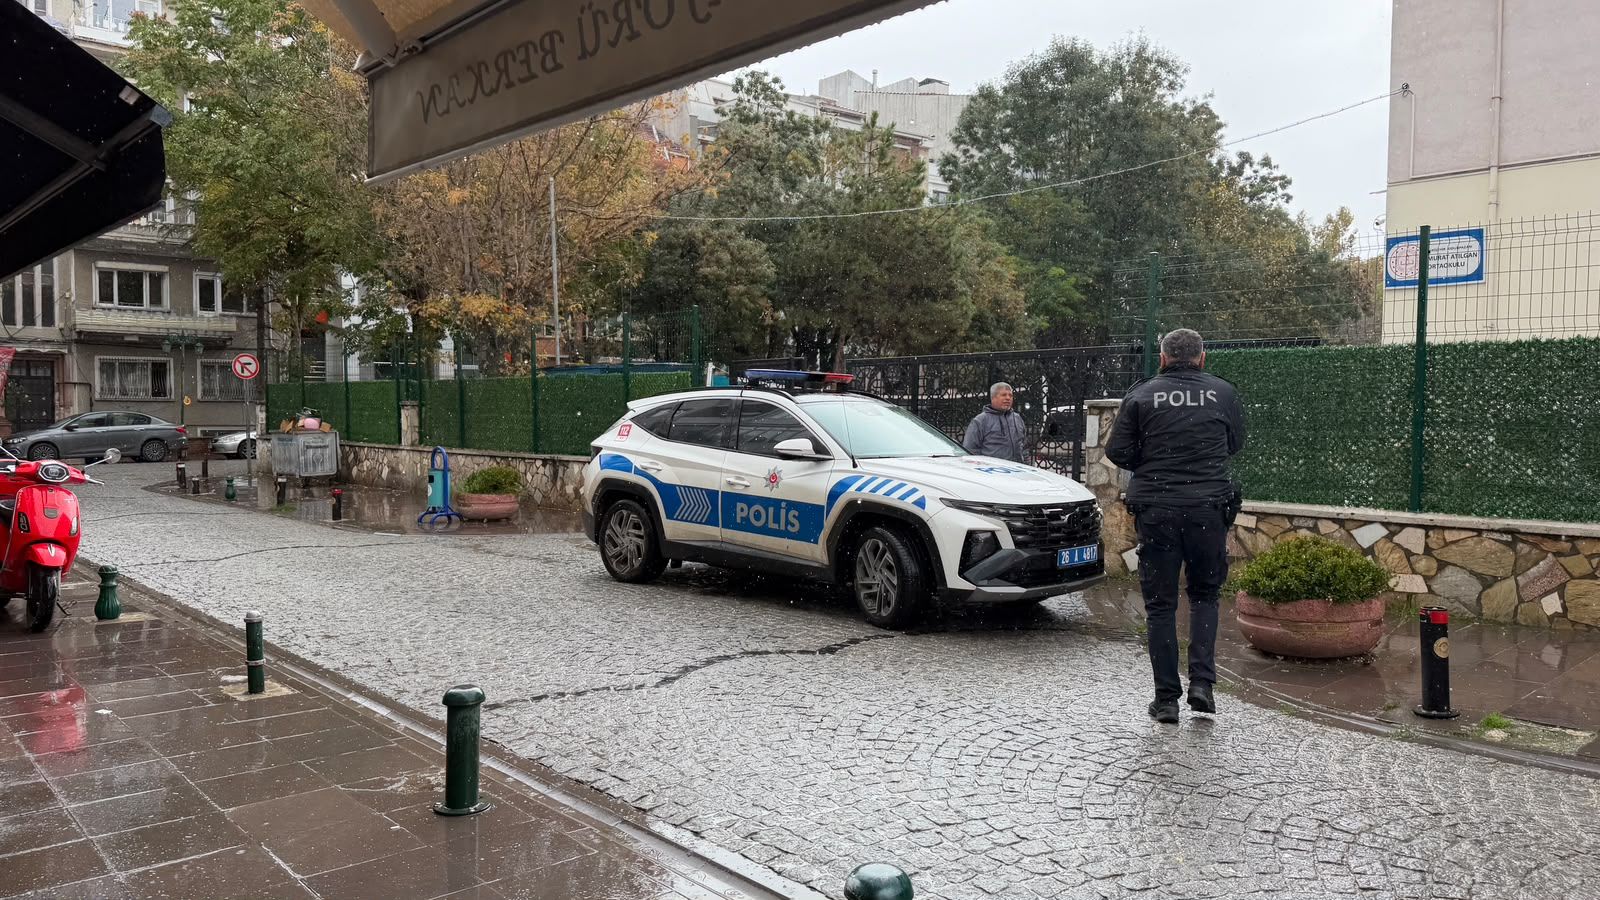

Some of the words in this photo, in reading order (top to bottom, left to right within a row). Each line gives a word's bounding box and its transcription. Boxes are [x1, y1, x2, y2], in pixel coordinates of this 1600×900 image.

[1450, 252, 1478, 260] ATILGAN
[736, 501, 801, 533] POLİS
[1061, 550, 1070, 564] 26
[1074, 549, 1079, 562] A
